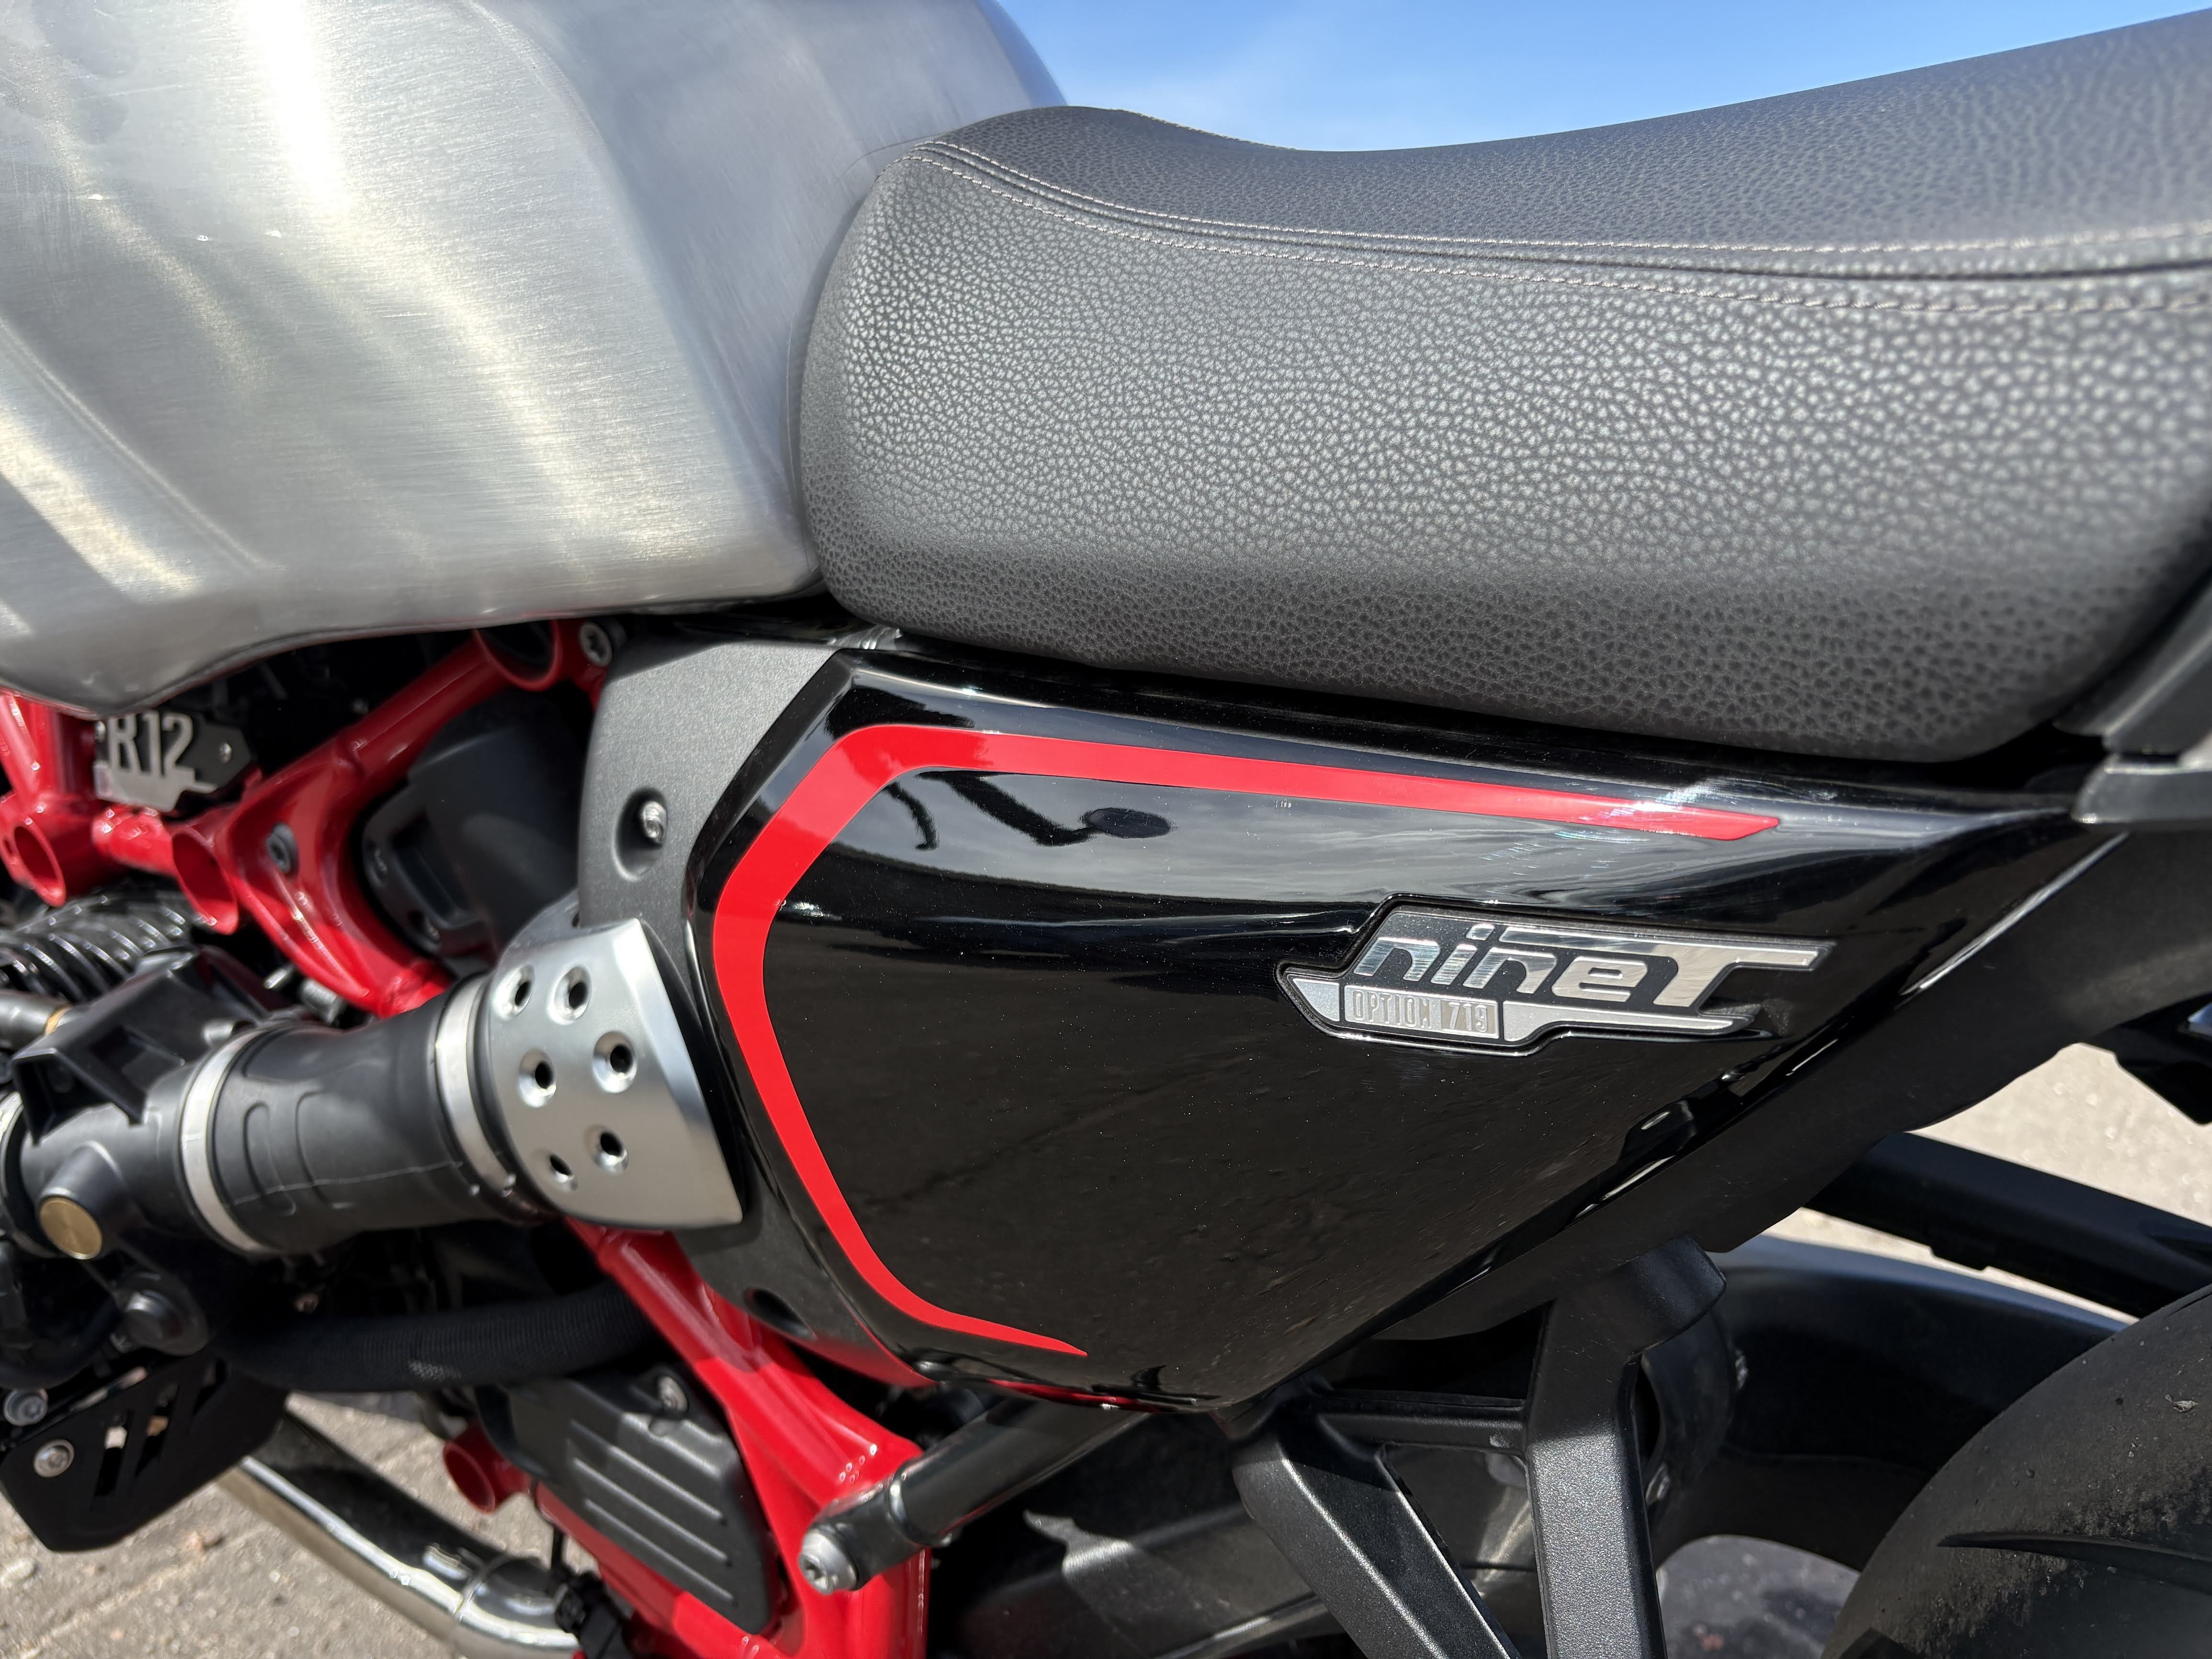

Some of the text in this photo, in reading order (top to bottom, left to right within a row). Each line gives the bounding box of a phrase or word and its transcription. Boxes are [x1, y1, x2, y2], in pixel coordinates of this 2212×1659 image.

[108, 710, 194, 779] R12
[1353, 923, 1819, 1008] nineT
[1352, 990, 1487, 1033] OPTION 719
